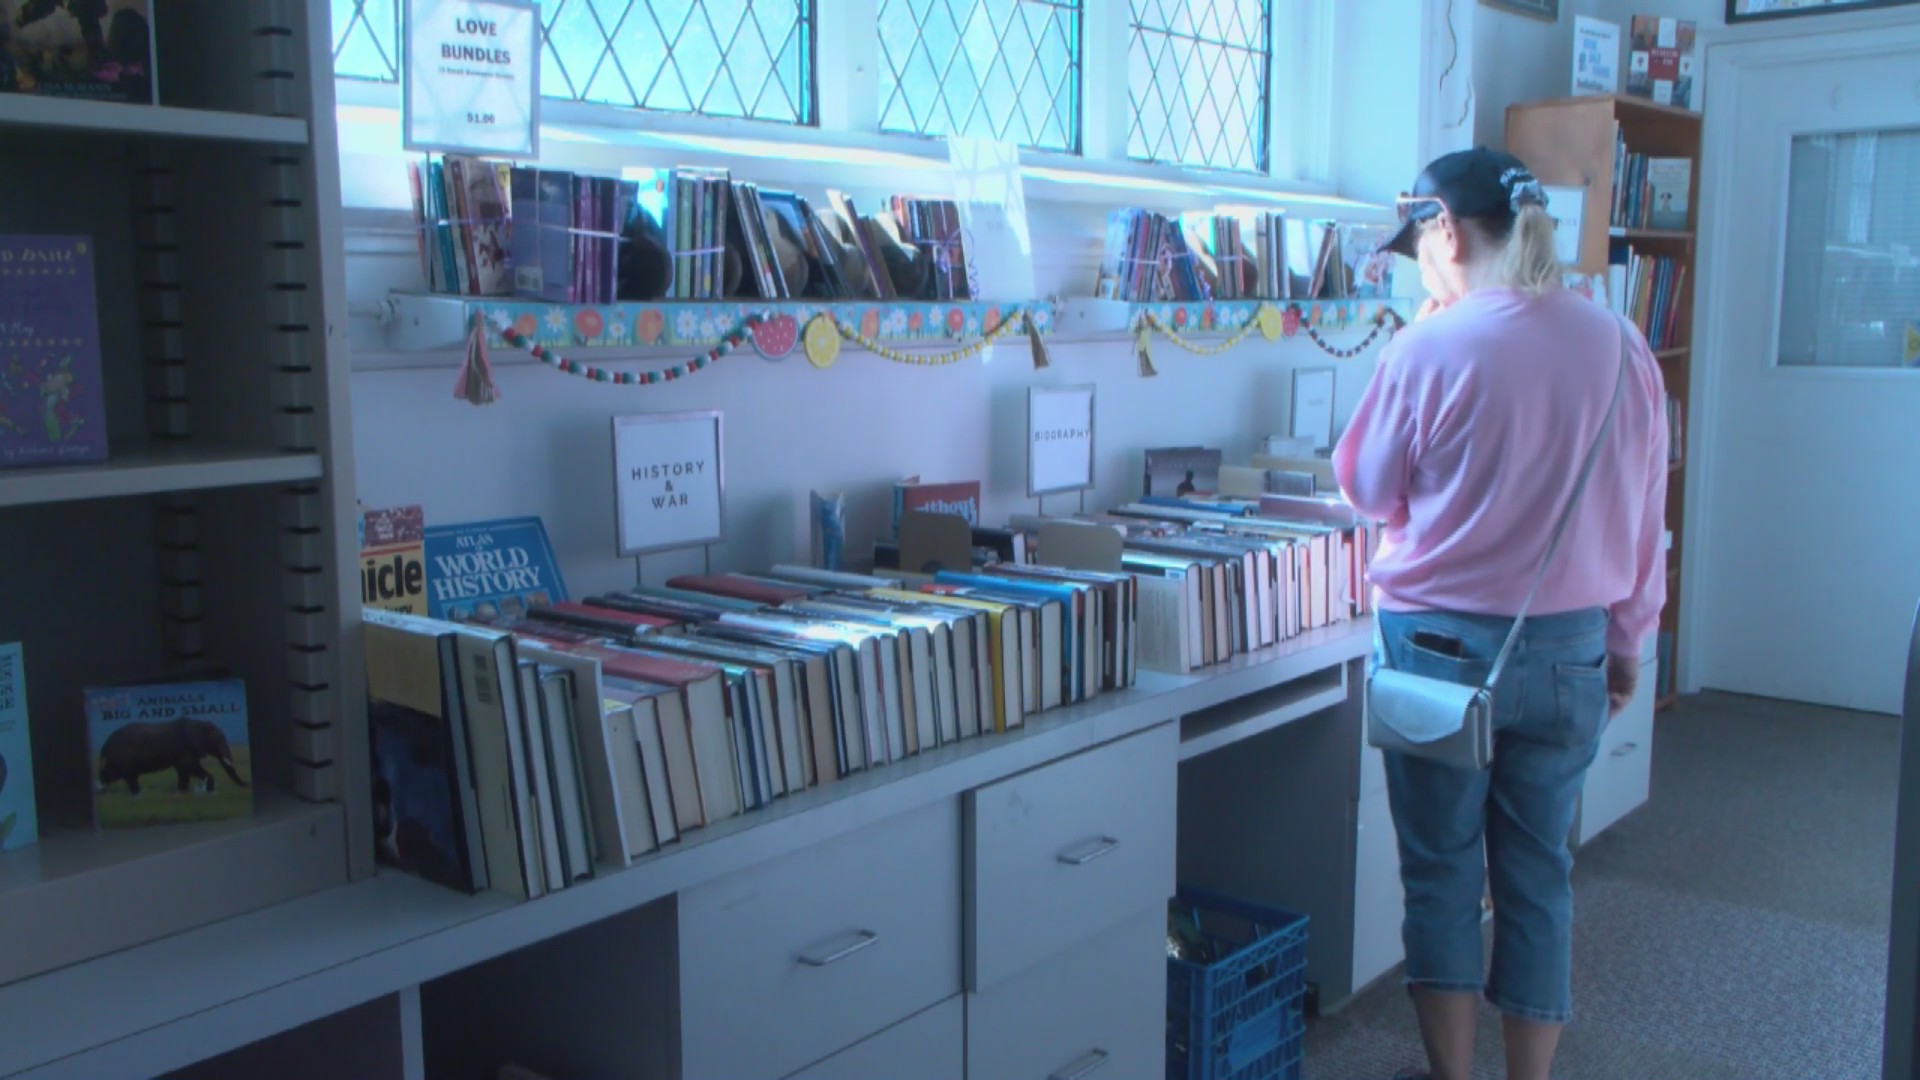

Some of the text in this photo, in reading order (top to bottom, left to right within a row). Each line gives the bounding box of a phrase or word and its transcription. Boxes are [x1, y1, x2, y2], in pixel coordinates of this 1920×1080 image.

[456, 18, 497, 37] LOVE
[441, 44, 511, 65] BUNDLES
[1034, 428, 1089, 442] BIOGRAPHY
[631, 460, 704, 481] HISTORY
[665, 480, 674, 493] &
[651, 493, 689, 510] WAR
[456, 533, 494, 549] ATLAS
[435, 546, 529, 577] WORLD
[432, 566, 542, 601] HISTORY
[137, 693, 206, 707] ANIMALS
[102, 702, 241, 721] BIG AND SMALL
